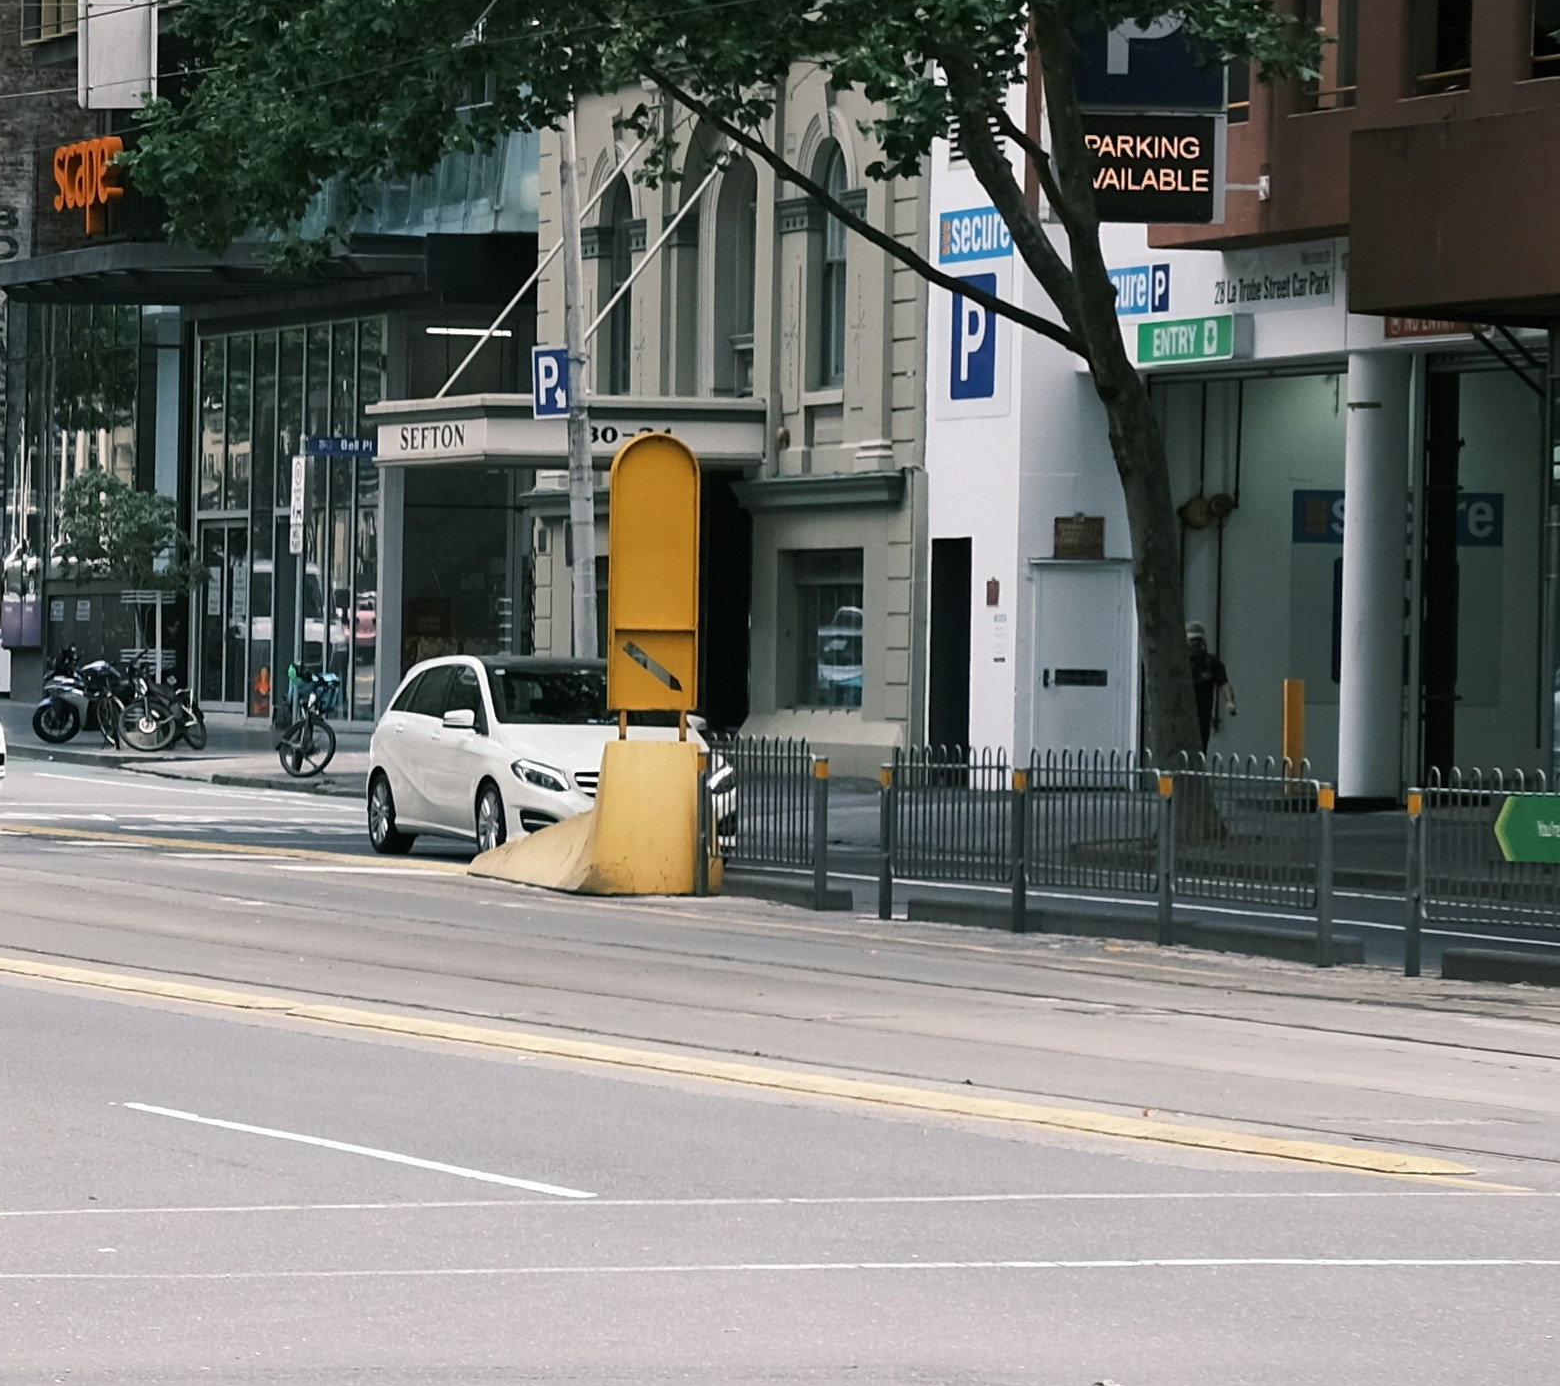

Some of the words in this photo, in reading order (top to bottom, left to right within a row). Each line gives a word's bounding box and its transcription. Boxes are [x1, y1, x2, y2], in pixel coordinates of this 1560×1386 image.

[1092, 167, 1210, 192] VAILABLE
[951, 214, 1011, 255] secure
[1154, 271, 1166, 307] P
[1227, 280, 1237, 304] La
[1239, 277, 1261, 302] Trobe
[1264, 275, 1291, 300] Street
[1293, 272, 1308, 297] Car
[1309, 270, 1331, 295] Park
[960, 295, 987, 382] P
[1153, 324, 1197, 357] ENTRY
[538, 355, 559, 406] P
[400, 424, 466, 450] SEFTON
